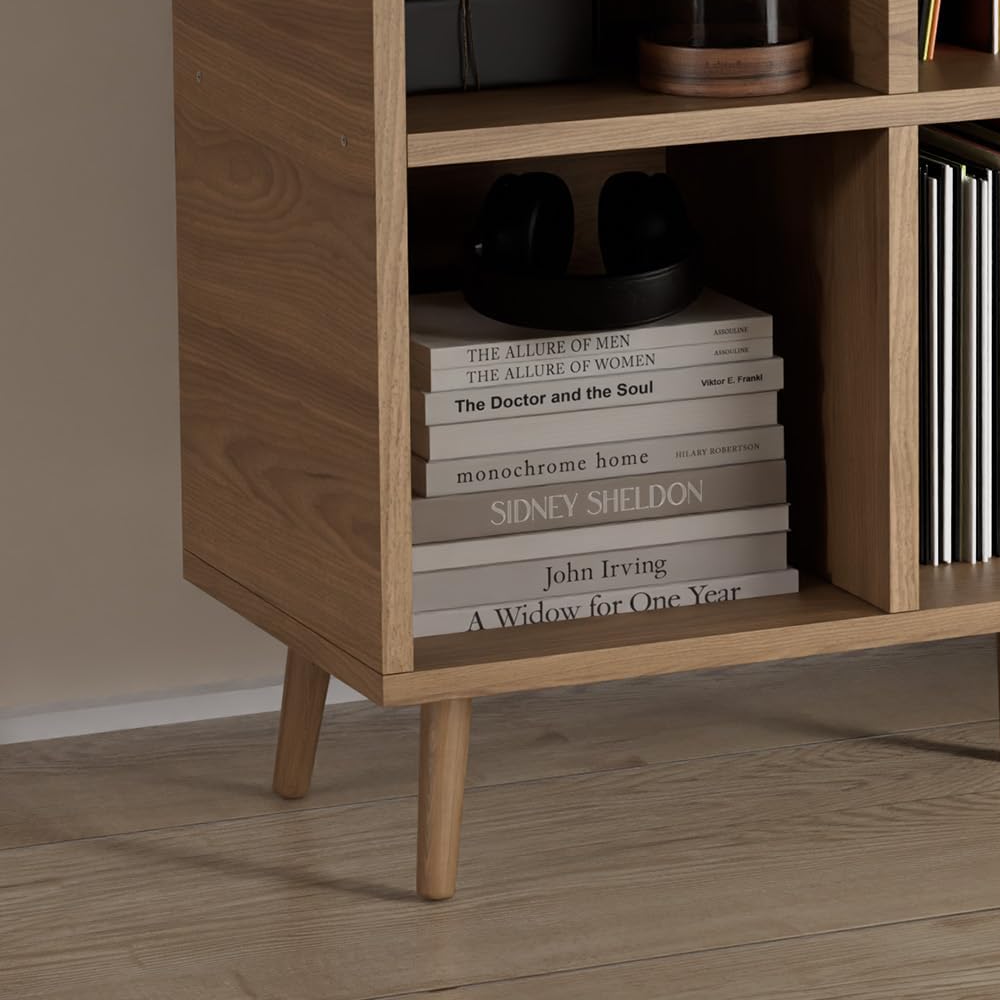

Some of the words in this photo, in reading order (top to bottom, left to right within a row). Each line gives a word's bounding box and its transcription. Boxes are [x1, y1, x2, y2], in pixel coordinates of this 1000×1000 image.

[713, 327, 748, 336] ASSOULINE
[466, 347, 500, 362] THE
[505, 340, 566, 359] ALLURE
[570, 338, 592, 352] OF
[595, 334, 631, 350] MEN
[713, 347, 749, 356] ASSOULINE
[466, 369, 500, 384] THE
[504, 362, 565, 380] ALLURE
[569, 360, 591, 373] OF
[595, 353, 656, 371] WOMEN
[701, 378, 725, 387] Viktor
[738, 373, 763, 383] Frankl
[455, 399, 486, 413] The
[491, 393, 546, 410] Doctor
[551, 388, 581, 403] and
[586, 386, 612, 399] the
[617, 380, 654, 397] Soul
[675, 447, 706, 459] HILARY
[709, 443, 760, 455] ROBERTSON
[456, 459, 587, 484] monochrome
[596, 451, 649, 469] home
[490, 492, 578, 526] SIDNEY
[587, 479, 703, 515] SHELDON
[543, 562, 593, 591] John
[602, 557, 667, 579] Irving
[465, 610, 486, 632] A
[495, 601, 581, 627] Widow
[589, 594, 624, 617] for
[629, 591, 681, 612] One
[688, 583, 742, 604] Year
